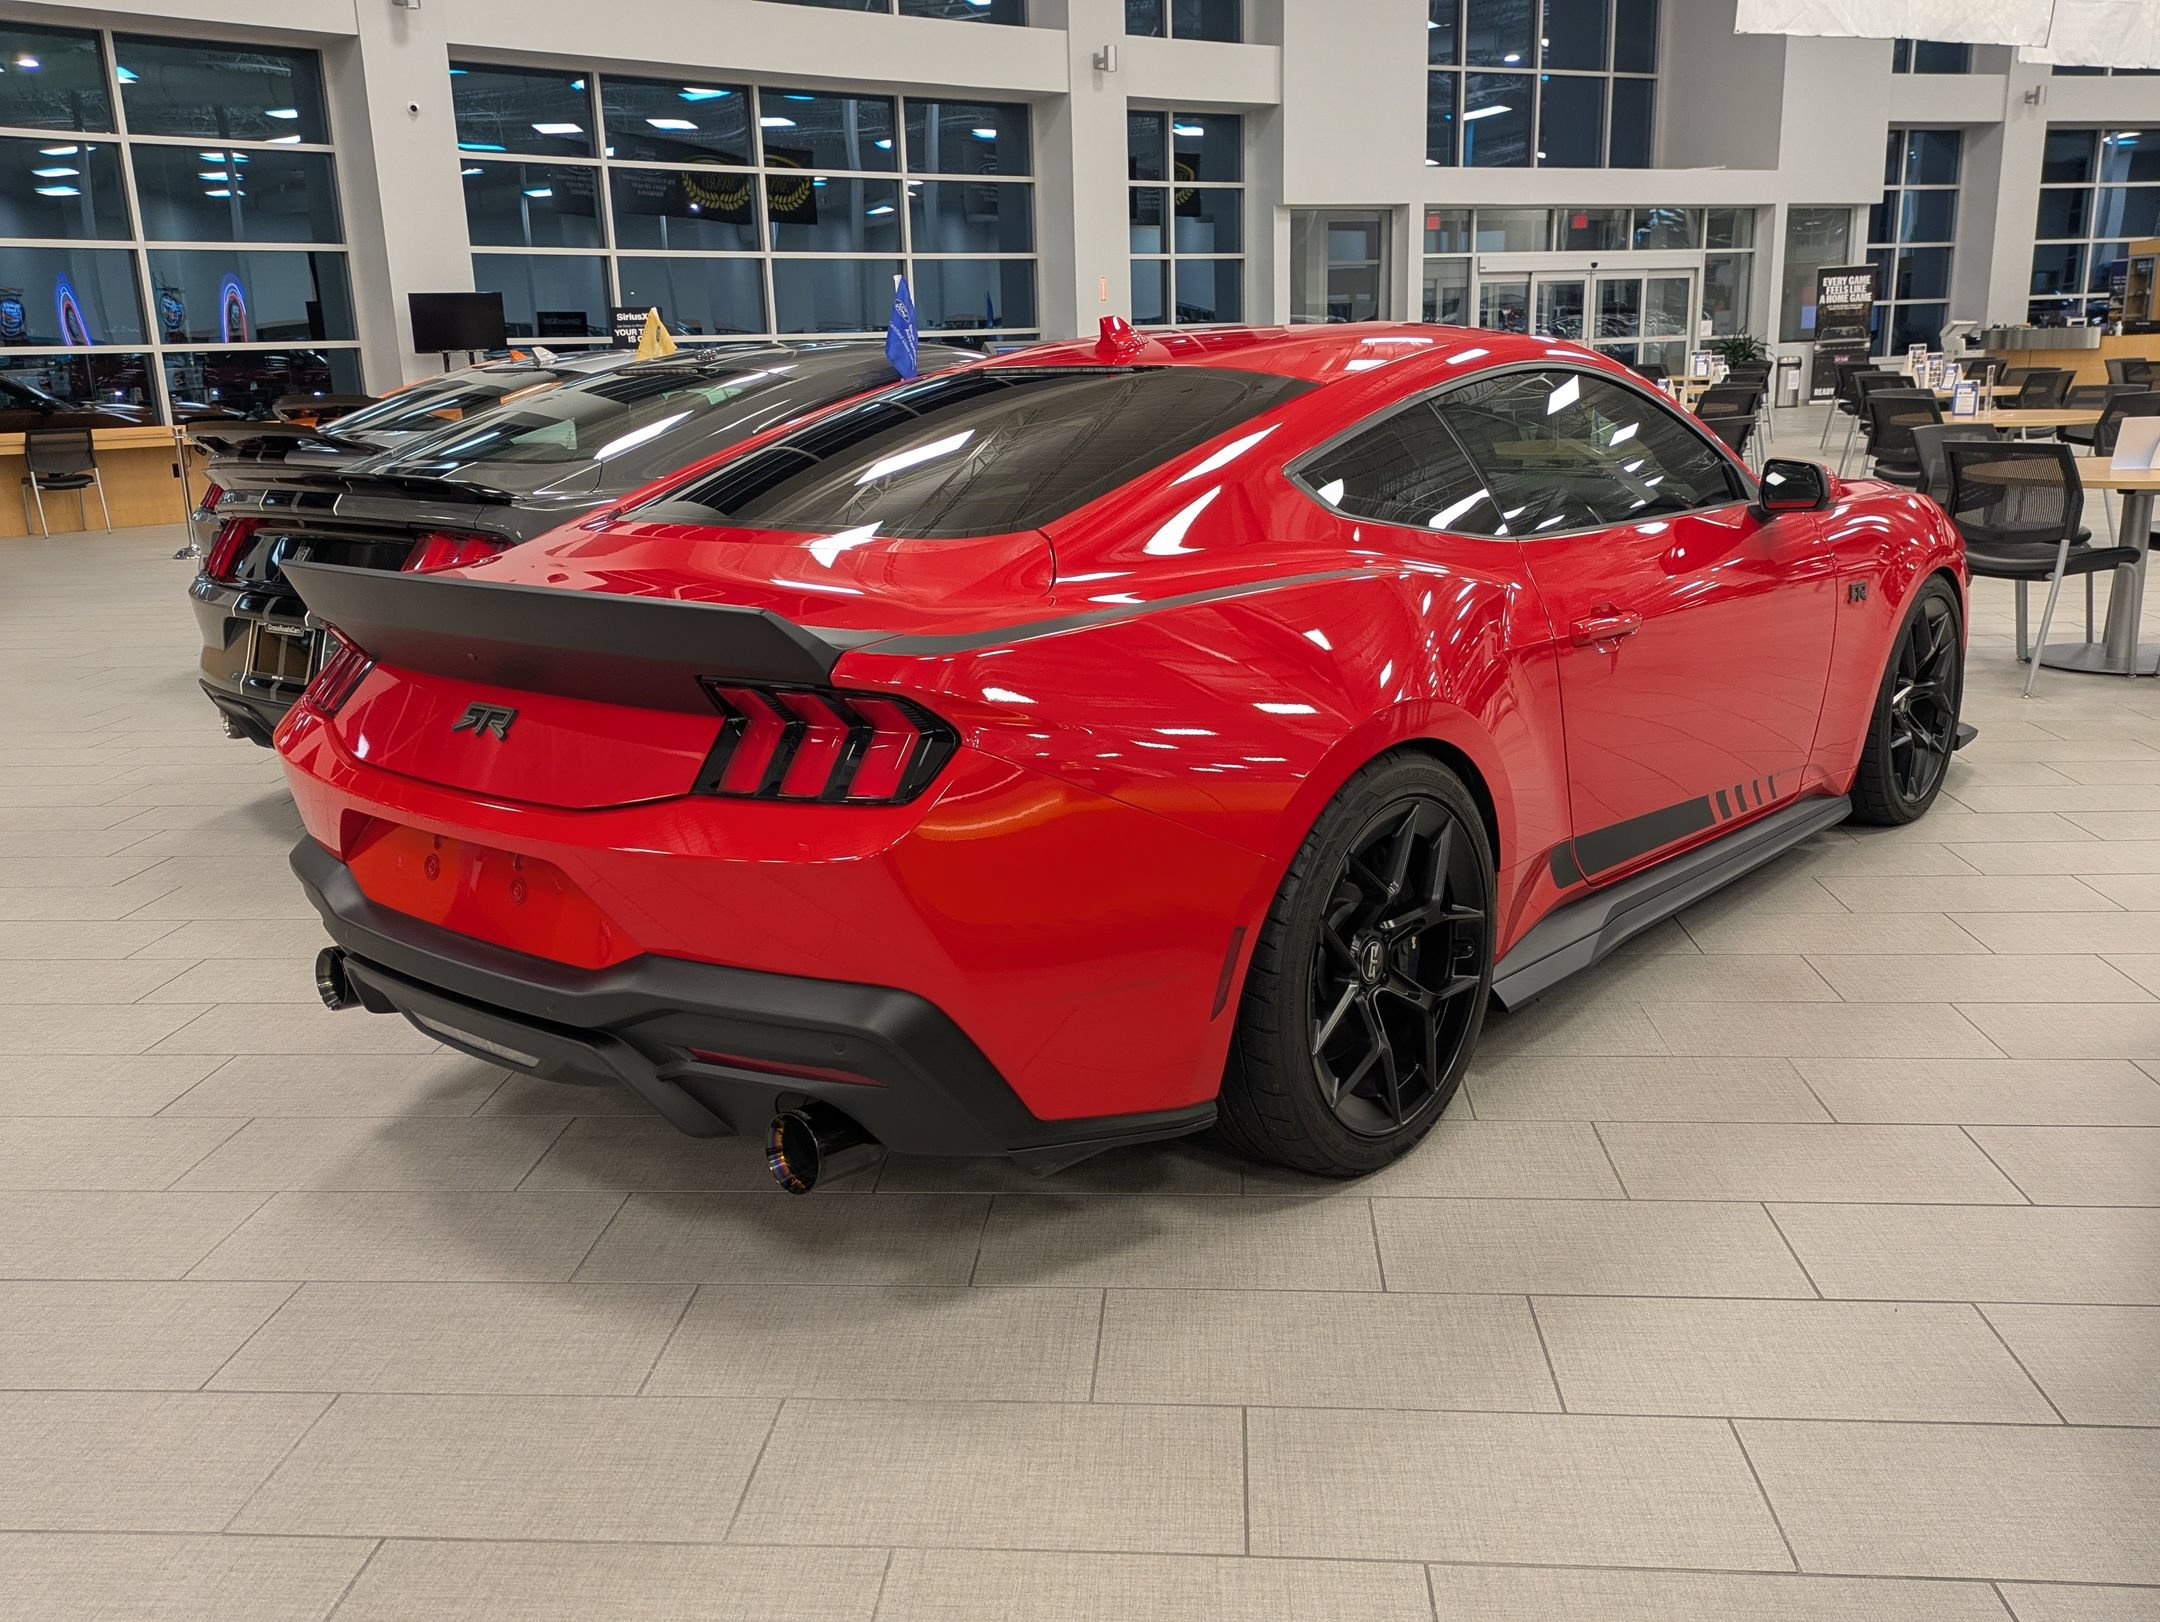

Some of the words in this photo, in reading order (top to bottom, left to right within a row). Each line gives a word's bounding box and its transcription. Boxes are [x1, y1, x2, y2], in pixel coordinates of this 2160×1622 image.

[1823, 277, 1848, 287] EVERY
[1848, 275, 1871, 285] GAME
[1825, 286, 1849, 295] FEELS
[1849, 285, 1867, 293] LIKE
[1819, 295, 1826, 304] A
[1826, 294, 1849, 304] HOME
[1849, 293, 1872, 302] GAME
[616, 312, 648, 321] SiriusX
[614, 328, 638, 337] YOUR
[628, 335, 637, 343] IS
[1814, 388, 1835, 396] READY
[452, 701, 517, 742] RTR
